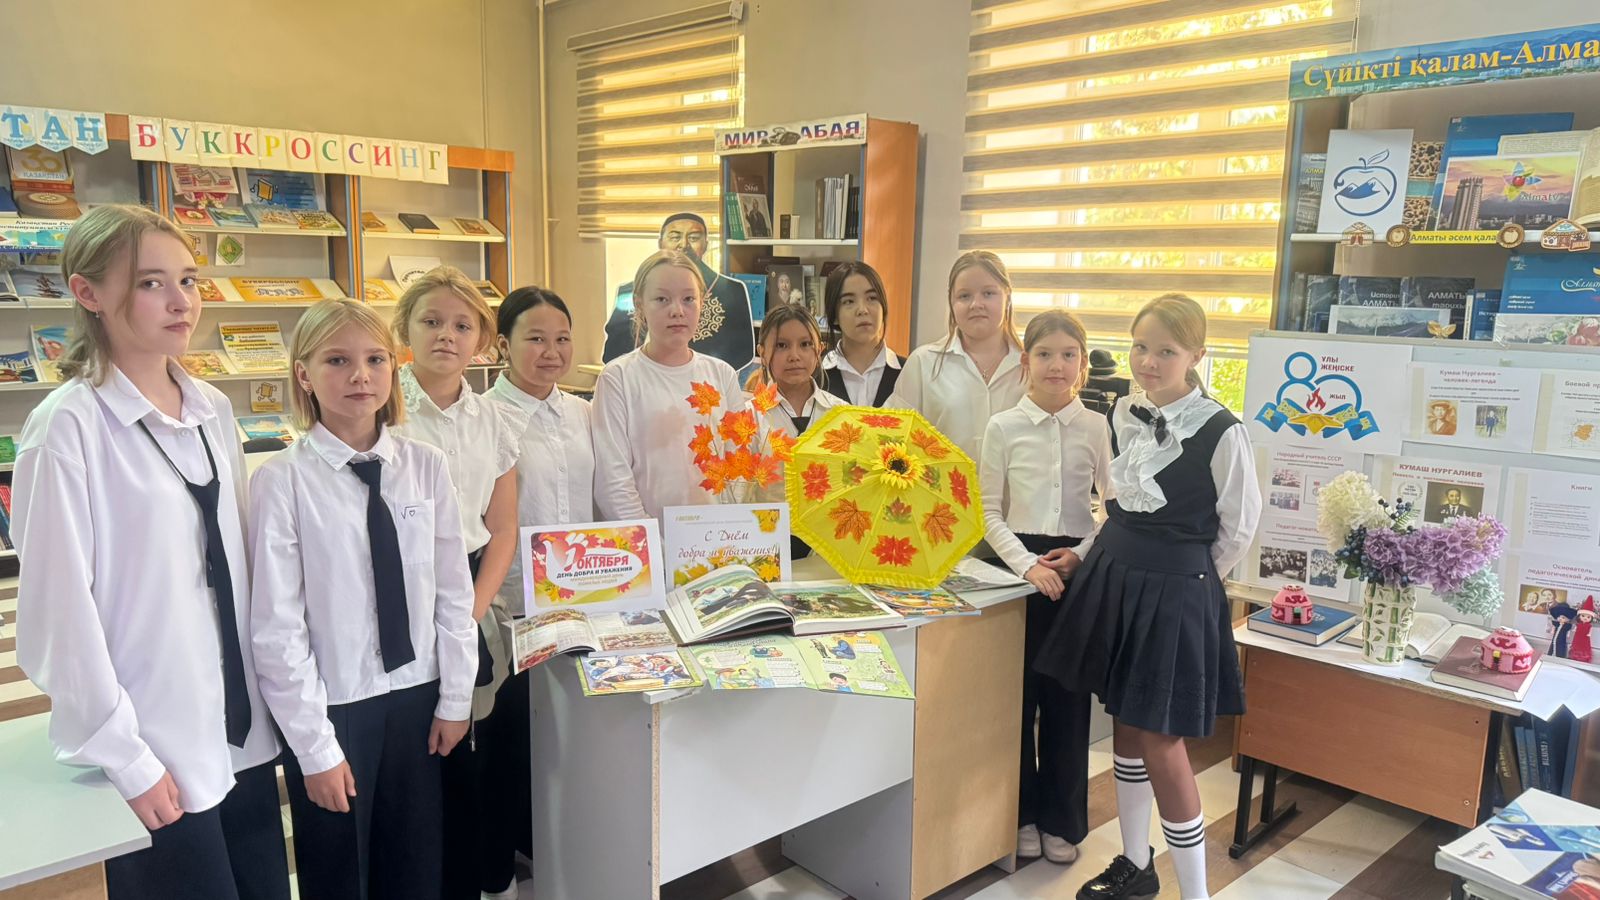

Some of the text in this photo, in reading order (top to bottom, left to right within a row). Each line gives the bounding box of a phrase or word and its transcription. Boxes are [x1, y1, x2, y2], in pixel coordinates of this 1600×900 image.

[1303, 55, 1401, 90] Сүйікті
[724, 120, 861, 147] МИР АБАЯ
[136, 123, 441, 171] БУККРОССИНГ
[1410, 233, 1497, 244] Алматы әсем қала
[1399, 464, 1483, 478] КУМАШ НУРГАЛИЕВ
[704, 529, 749, 542] С Днём
[678, 544, 706, 562] добра
[722, 544, 777, 561] уважения!
[577, 554, 629, 570] ОКТЯБРЯ
[1552, 563, 1593, 574] Основатель
[574, 569, 594, 577] ДОБРА
[600, 566, 633, 575] УВАЖЕНИЯ
[1527, 568, 1582, 579] педагогической
